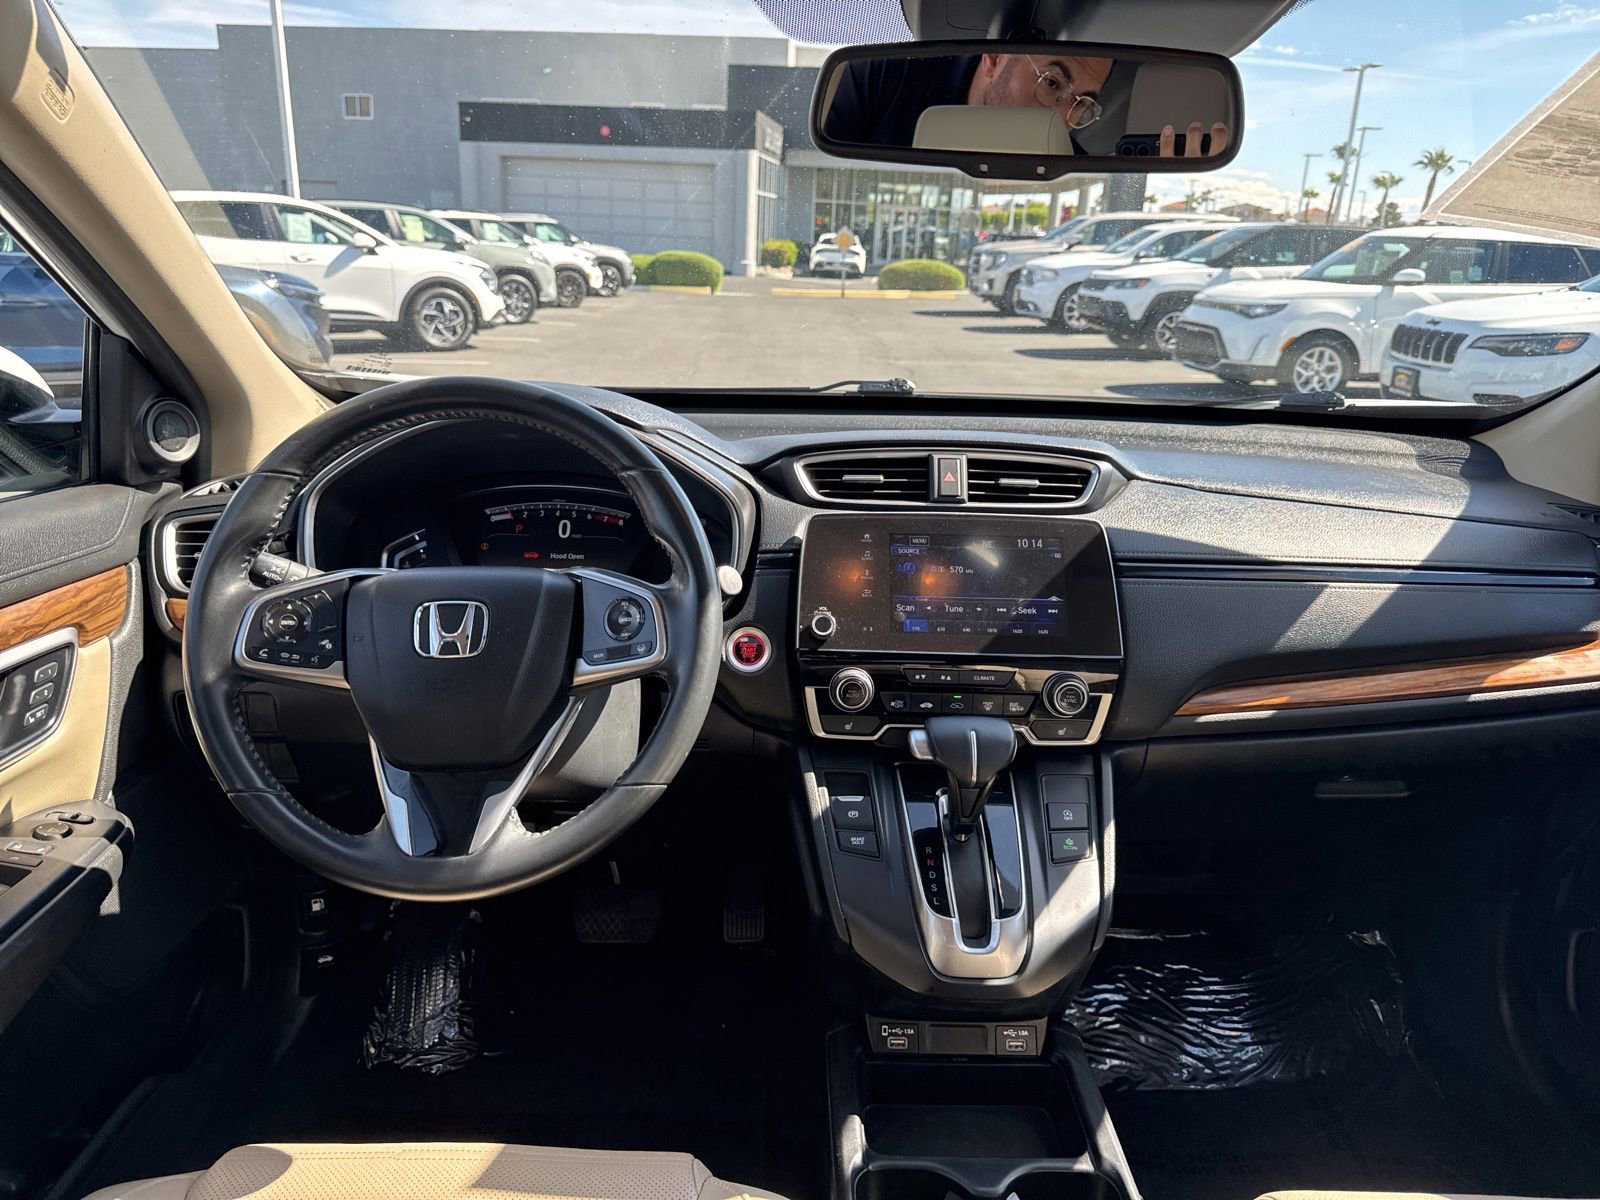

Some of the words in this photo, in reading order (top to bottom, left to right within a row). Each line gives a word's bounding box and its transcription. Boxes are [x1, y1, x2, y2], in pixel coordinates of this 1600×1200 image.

[515, 524, 523, 534] P
[558, 519, 571, 539] 0
[262, 570, 280, 581] AUTO
[896, 603, 915, 612] Scan
[945, 604, 964, 613] Tune
